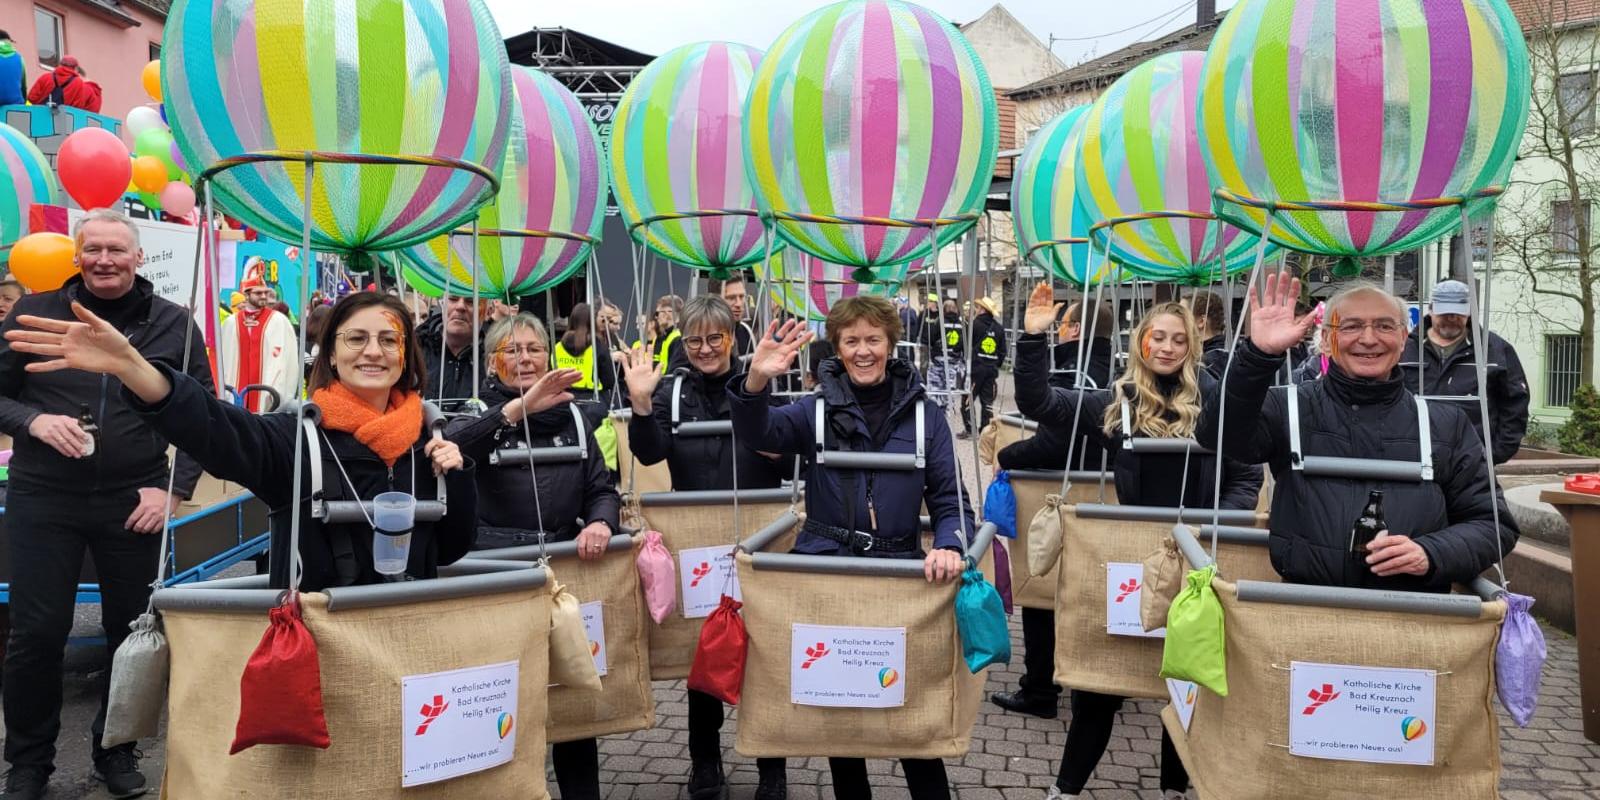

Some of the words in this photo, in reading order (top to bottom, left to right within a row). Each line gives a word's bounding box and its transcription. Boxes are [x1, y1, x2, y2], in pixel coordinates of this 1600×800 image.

[162, 249, 173, 261] End
[832, 637, 871, 646] Katholische
[873, 638, 895, 647] Kirche
[838, 648, 852, 656] Bad
[854, 648, 890, 657] Kreuznach
[842, 659, 863, 667] Heilig
[451, 682, 491, 695] Katholische
[493, 678, 512, 688] Kirche
[1343, 679, 1392, 691] Katholische
[1394, 681, 1422, 692] Kirche
[457, 697, 472, 707] Bad
[474, 691, 507, 704] Kreuznach
[1349, 691, 1367, 700] Bad
[1370, 693, 1416, 703] Kreuznach
[462, 709, 483, 719] Heilig
[485, 705, 503, 715] Kreuz
[1355, 704, 1381, 715] Heilig
[1384, 706, 1408, 715] Kreuz
[1320, 741, 1359, 750] probieren
[1361, 743, 1386, 753] Neues
[1387, 745, 1403, 753] aus!
[433, 756, 466, 770] probieren
[467, 751, 487, 761] Neues
